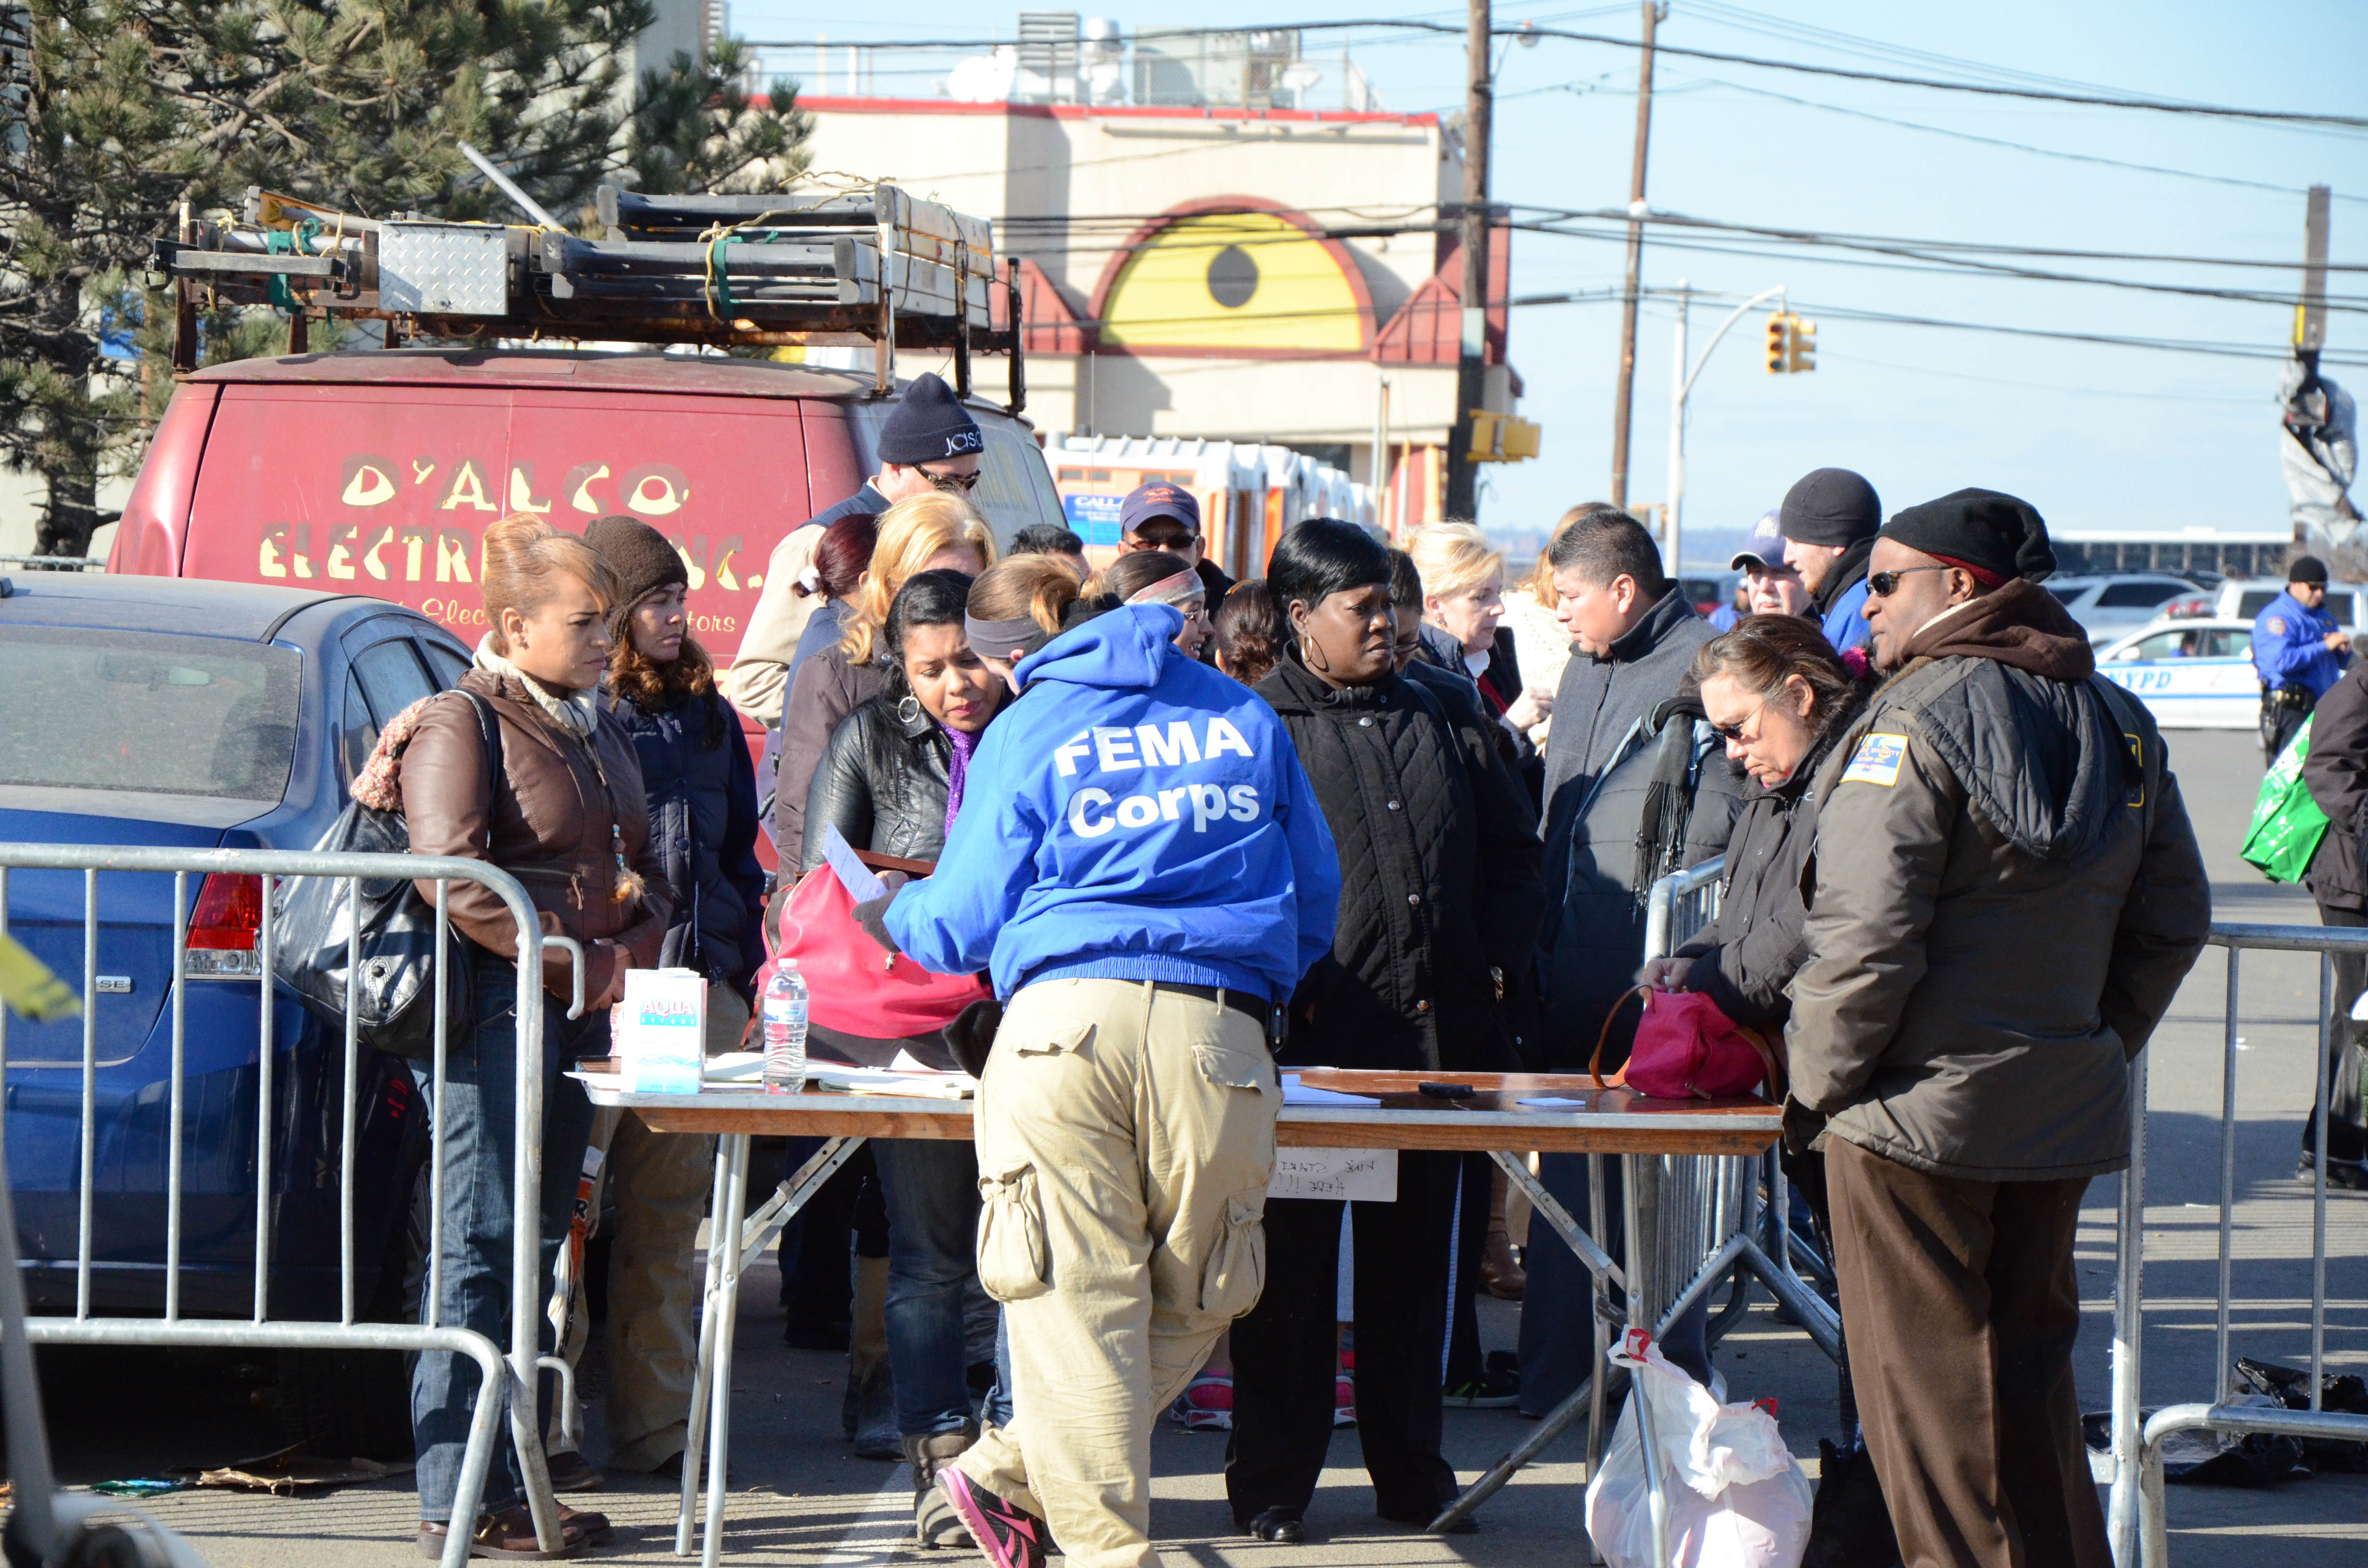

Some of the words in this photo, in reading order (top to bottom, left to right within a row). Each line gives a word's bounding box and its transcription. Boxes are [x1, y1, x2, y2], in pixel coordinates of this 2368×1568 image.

[1054, 717, 1254, 777] FEMA
[1871, 747, 1900, 757] SECURITY
[1068, 783, 1260, 838] Corps
[100, 980, 126, 988] SE
[641, 999, 696, 1018] AQUA
